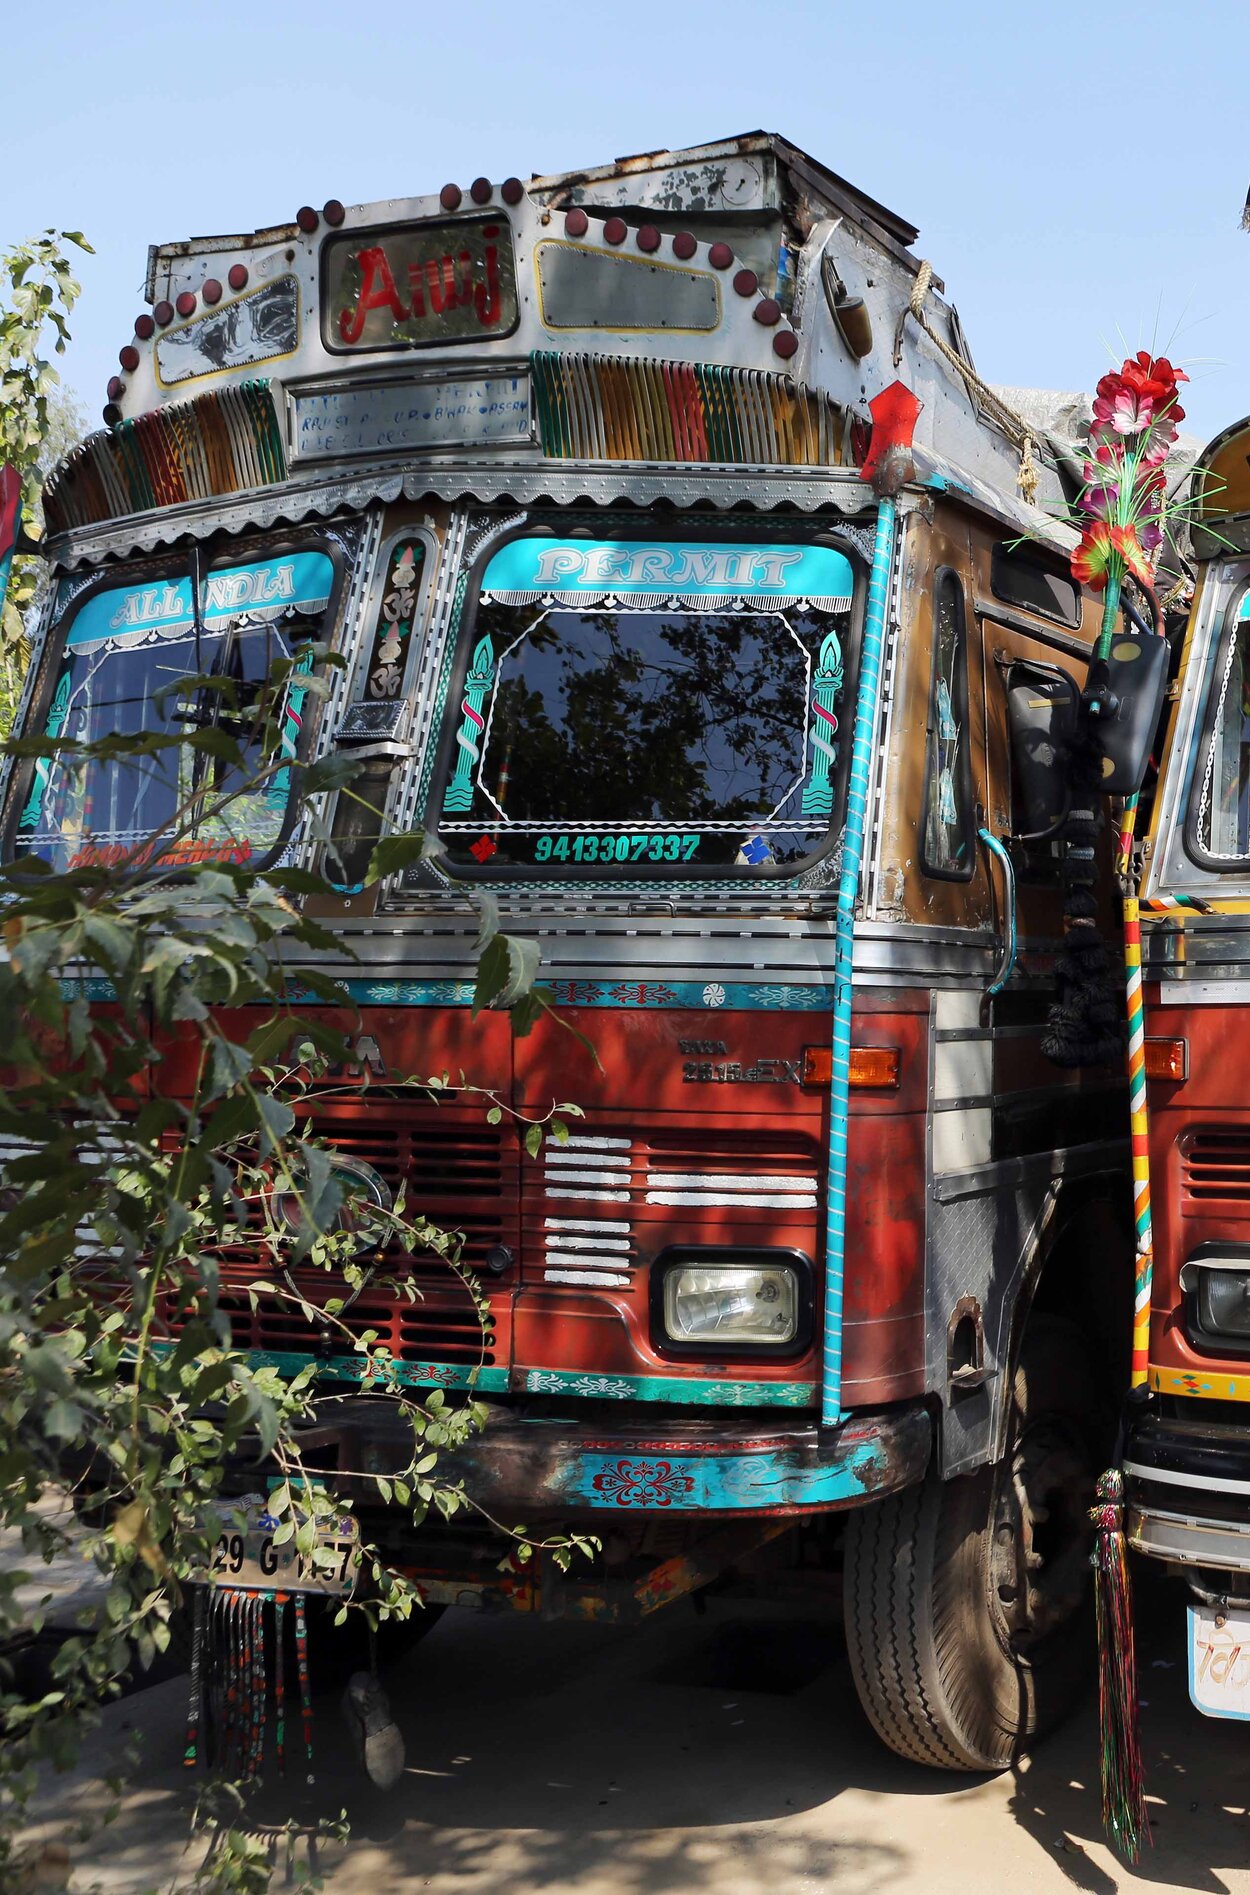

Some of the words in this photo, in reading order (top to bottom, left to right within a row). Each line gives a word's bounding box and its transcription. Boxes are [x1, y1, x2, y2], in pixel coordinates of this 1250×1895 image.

[533, 547, 803, 588] PERMIT
[109, 585, 183, 630] ALL
[188, 563, 296, 614] NDIA
[534, 834, 701, 862] 9413307337
